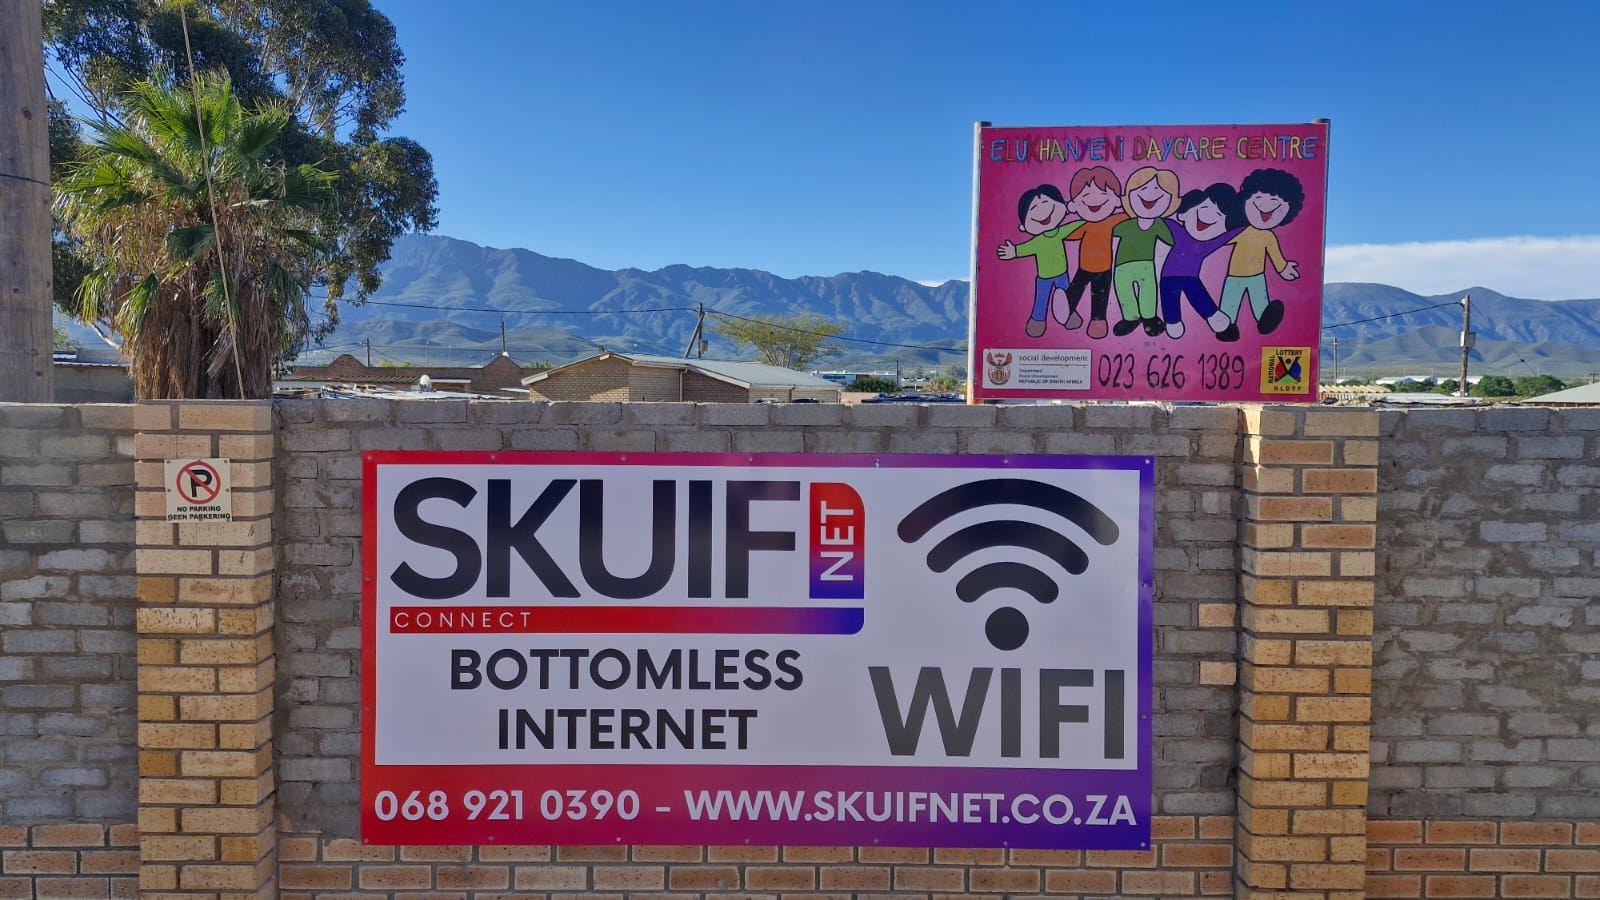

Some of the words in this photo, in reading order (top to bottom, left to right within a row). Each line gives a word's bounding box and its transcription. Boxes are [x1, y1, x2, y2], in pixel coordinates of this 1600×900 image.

[1132, 135, 1227, 161] DAYCARE
[1236, 136, 1318, 160] CENTRE
[1019, 354, 1039, 362] social
[1041, 354, 1088, 363] development
[1098, 353, 1135, 389] 023
[1146, 353, 1186, 390] 626
[1197, 352, 1245, 390] 1389
[1267, 355, 1276, 384] NATIONAL
[390, 476, 801, 600] SKUIF
[819, 500, 855, 582] NET
[394, 611, 532, 629] CONNECT
[450, 648, 804, 691] BOTTOMLESS
[498, 708, 758, 750] INTERNET
[867, 666, 1126, 760] WIFI
[374, 790, 450, 821] 068
[463, 789, 523, 821] 921
[540, 789, 641, 821] 0390
[684, 790, 1138, 826] WWW.SKUIFNET.CO.ZA
